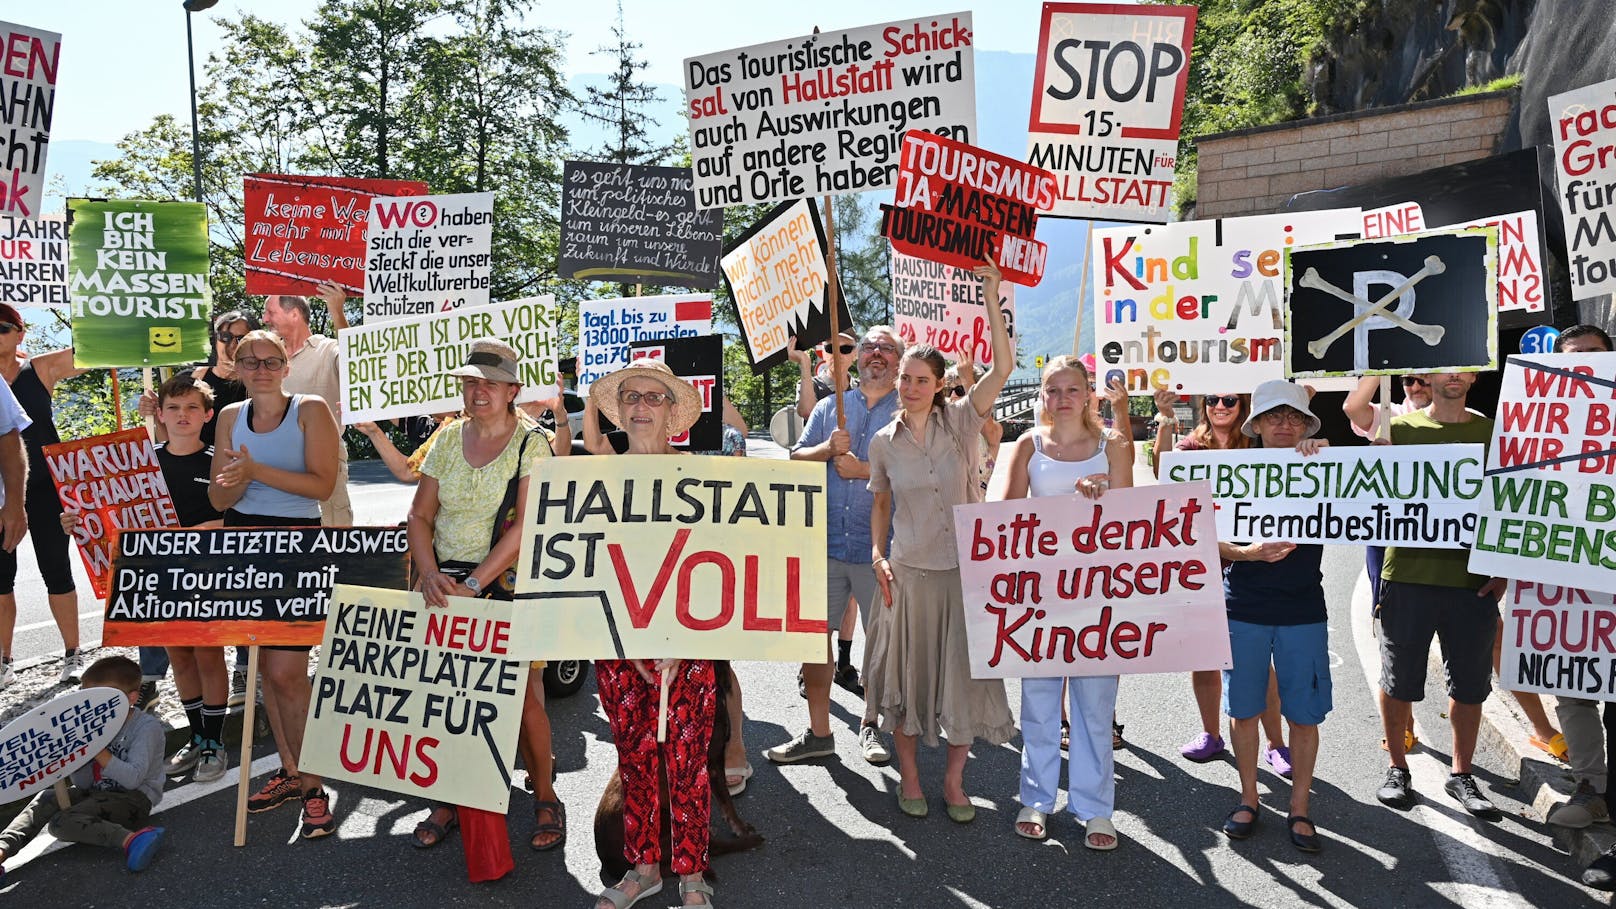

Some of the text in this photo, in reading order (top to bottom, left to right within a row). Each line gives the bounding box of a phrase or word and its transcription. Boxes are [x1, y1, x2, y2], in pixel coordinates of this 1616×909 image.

[0, 32, 61, 85] EN
[690, 61, 732, 89] Das
[737, 34, 872, 80] touristische
[1046, 39, 1183, 102] STOP
[690, 51, 962, 119] sal von Hallstatt wird
[694, 96, 941, 148] auch Auswirkungen
[697, 146, 734, 177] auf
[743, 139, 826, 171] andere
[905, 136, 1054, 210] TOURISMUS
[1028, 143, 1174, 175] MINUTEN FÜR
[570, 167, 667, 189] es geht uns
[699, 176, 742, 206] und
[751, 170, 804, 200] Orte
[896, 171, 931, 210] JA
[264, 194, 326, 219] keine
[569, 187, 686, 207] um politisches
[103, 211, 155, 232] ICH
[252, 219, 310, 240] mehr
[320, 219, 352, 242] mit
[441, 207, 492, 226] haben
[566, 220, 592, 231] um
[600, 221, 660, 238] unseren
[676, 209, 713, 225] geht
[1363, 206, 1420, 239] EINE
[41, 242, 61, 261] IN
[103, 231, 155, 249] BIN
[371, 231, 403, 250] sich
[408, 230, 431, 249] die
[563, 243, 628, 269] Zukunft
[634, 252, 661, 267] und
[565, 231, 687, 253] raum um unsere
[726, 213, 809, 284] wir können
[880, 203, 1046, 276] TOURISMUS NEIN
[96, 249, 167, 270] KEIN
[369, 252, 418, 271] steckt
[420, 250, 444, 269] die
[736, 239, 817, 307] nicht mehr
[1103, 237, 1199, 290] Kind
[71, 269, 207, 294] MASSEN
[369, 270, 488, 293] Weltkulturerbe
[895, 277, 984, 305] REMPELT BELE
[71, 295, 205, 319] TOURIST
[367, 295, 434, 317] schützen
[741, 266, 823, 335] freundlich
[896, 297, 946, 321] BEDROHT
[1104, 280, 1283, 330] in der M
[347, 323, 420, 358] HALLSTATT
[430, 318, 450, 345] IST
[459, 313, 495, 341] DER
[583, 309, 666, 329] tägl. bis zu
[584, 324, 697, 346] 13000 Touristen
[1353, 270, 1416, 370] P
[753, 322, 785, 357] sein
[1102, 326, 1283, 364] entourism
[1528, 333, 1556, 353] 30
[349, 350, 428, 385] BOTE DER
[584, 348, 607, 366] bei
[349, 381, 371, 412] EN
[1524, 366, 1595, 399] WIR
[1502, 402, 1569, 434] WIR
[48, 439, 159, 482] WARUM
[1499, 436, 1564, 470] WIR
[59, 471, 168, 511] SCHAUEN
[536, 478, 822, 527] HALLSTATT
[1491, 476, 1568, 518] WIR
[72, 512, 103, 545] SO
[122, 530, 408, 556] UNSER LETZTER AUSWEG
[971, 498, 1201, 561] bitte denkt
[119, 564, 339, 592] Die Touristen mit
[531, 528, 827, 633] IST VOLL
[990, 560, 1207, 605] an unsere
[109, 594, 263, 619] Aktionismus
[335, 603, 511, 654] KEINE NEUE
[985, 603, 1168, 667] Kinder
[1512, 609, 1616, 653] TOUR
[328, 638, 519, 695] PARKPLÄTZE
[1518, 653, 1602, 693] NICHTS
[51, 700, 91, 727] ICH
[62, 695, 120, 734] LIEBE
[84, 709, 116, 733] ICH
[314, 676, 504, 756] PLATZ FÜR
[19, 745, 88, 791] NICHT
[340, 724, 440, 787] UNS
